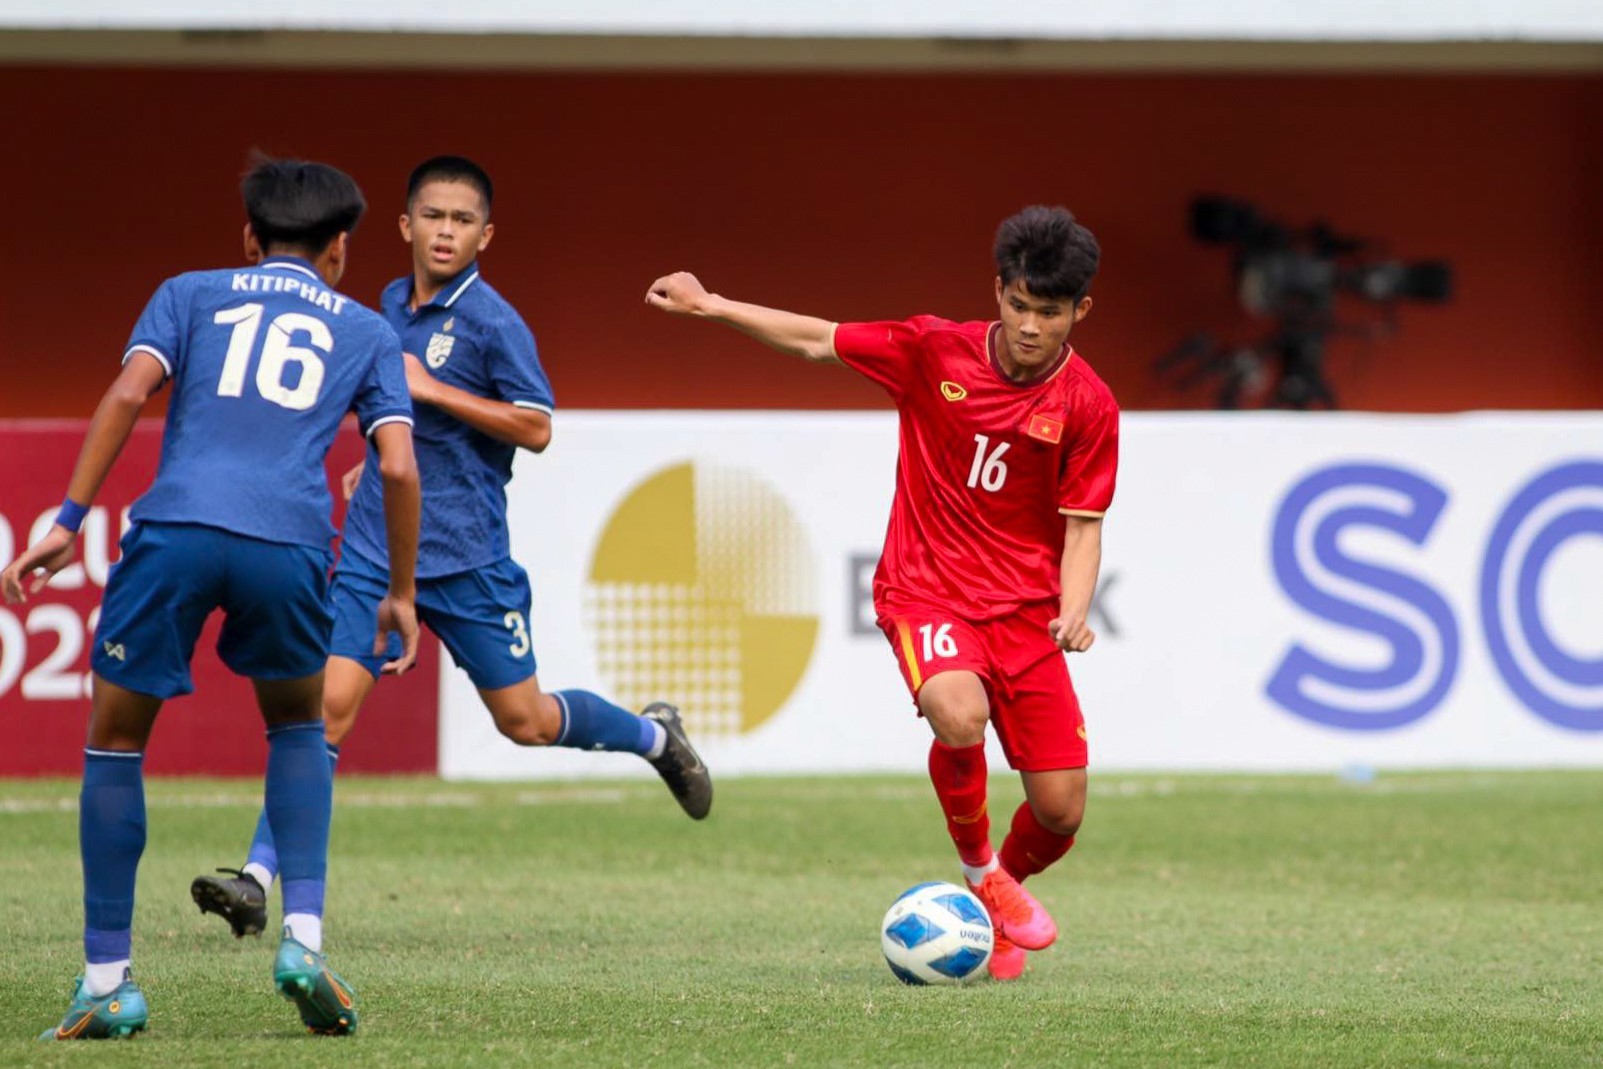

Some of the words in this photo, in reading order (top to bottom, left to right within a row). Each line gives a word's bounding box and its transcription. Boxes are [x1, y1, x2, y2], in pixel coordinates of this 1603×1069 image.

[231, 273, 347, 315] KITIPHAT
[213, 302, 334, 411] 16
[966, 433, 1011, 492] 16
[504, 610, 530, 658] 3
[919, 623, 958, 662] 16
